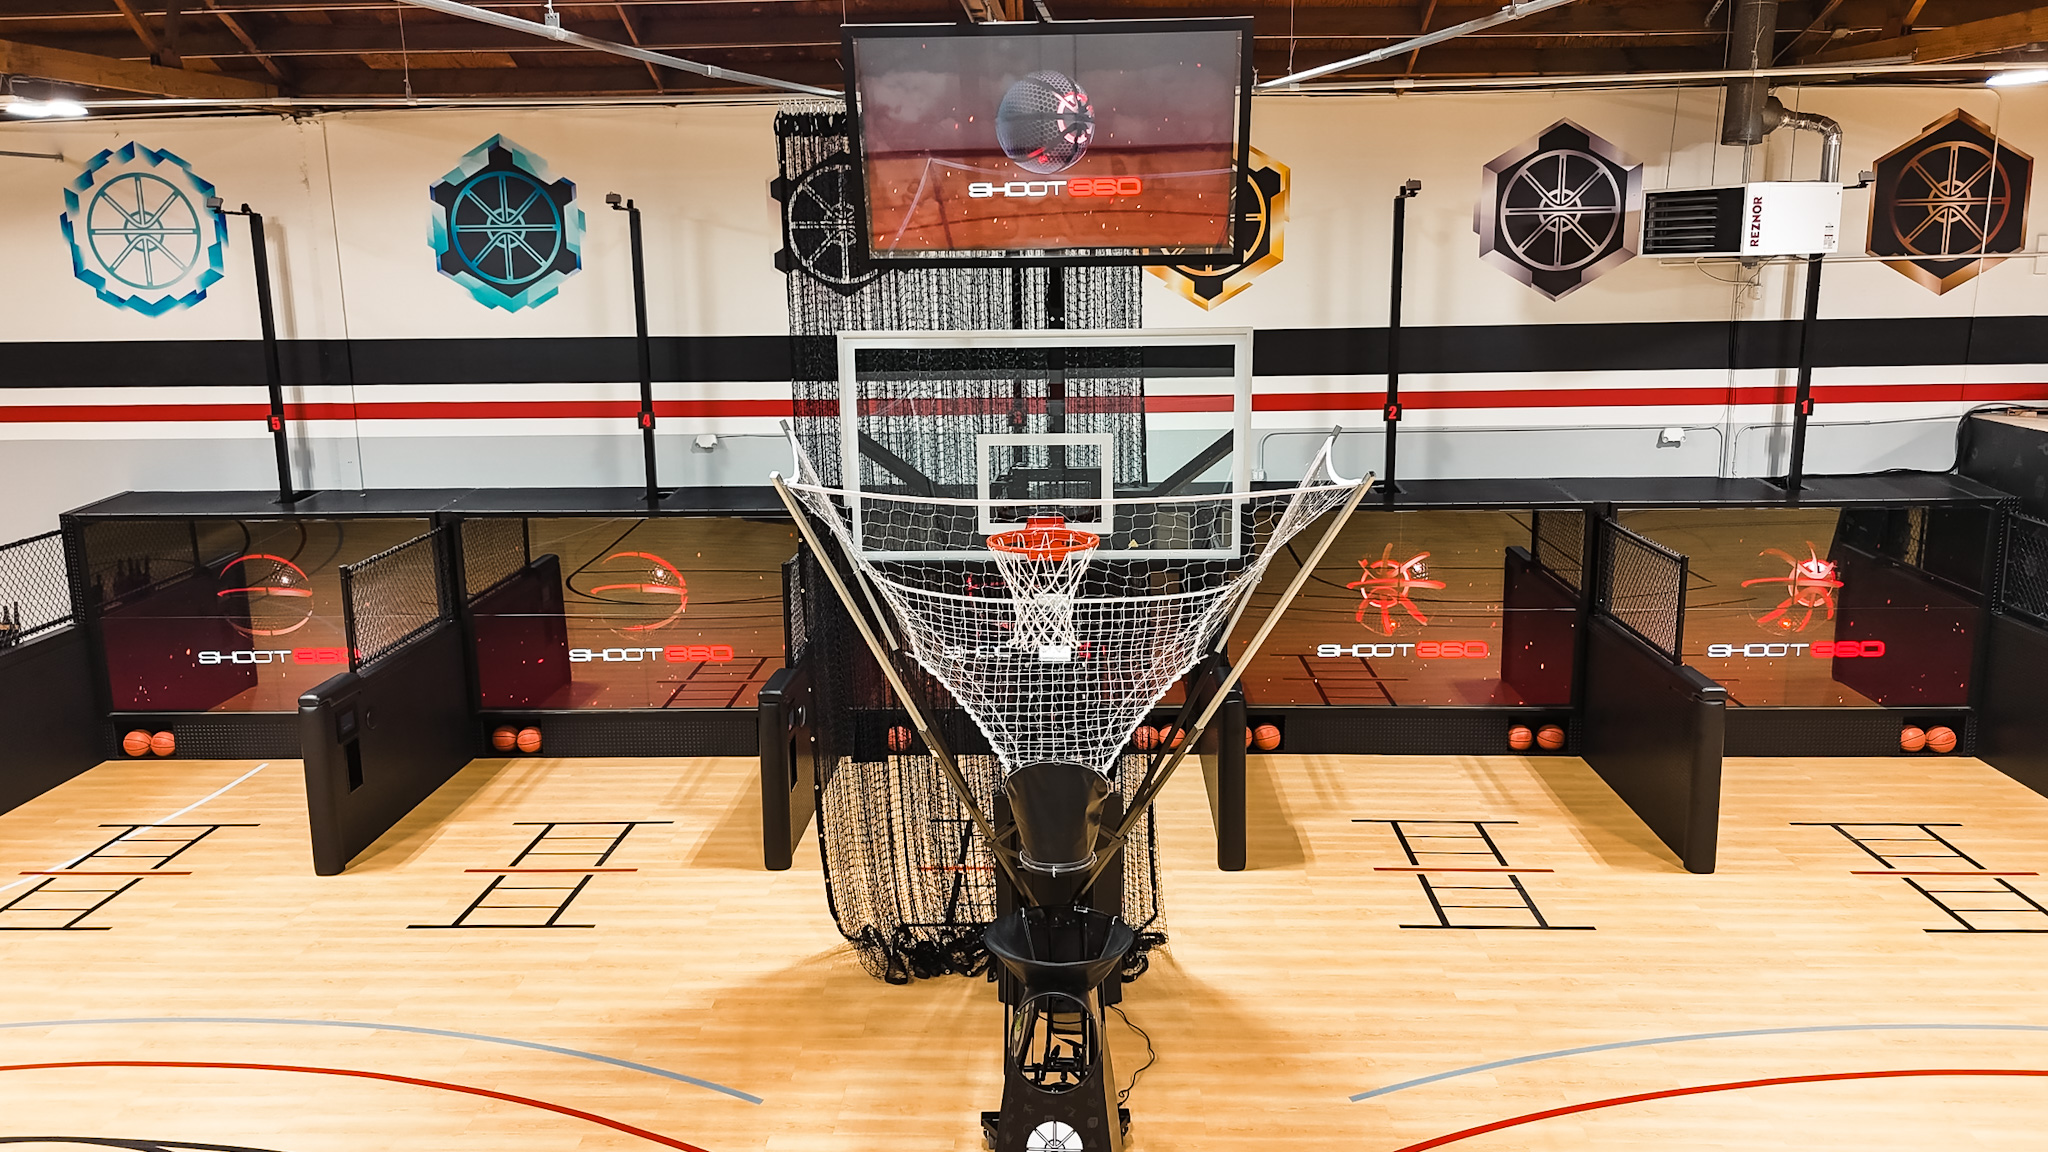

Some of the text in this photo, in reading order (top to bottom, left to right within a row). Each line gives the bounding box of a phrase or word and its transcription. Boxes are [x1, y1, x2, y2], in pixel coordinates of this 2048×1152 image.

[968, 177, 1142, 198] SHOOT360
[1750, 196, 1762, 247] REZNOR
[1388, 405, 1397, 419] 2
[1801, 400, 1808, 414] 1
[271, 416, 281, 430] 5
[642, 413, 651, 427] 4
[569, 645, 734, 662] SHOOT360
[1317, 641, 1488, 658] SHOOT360
